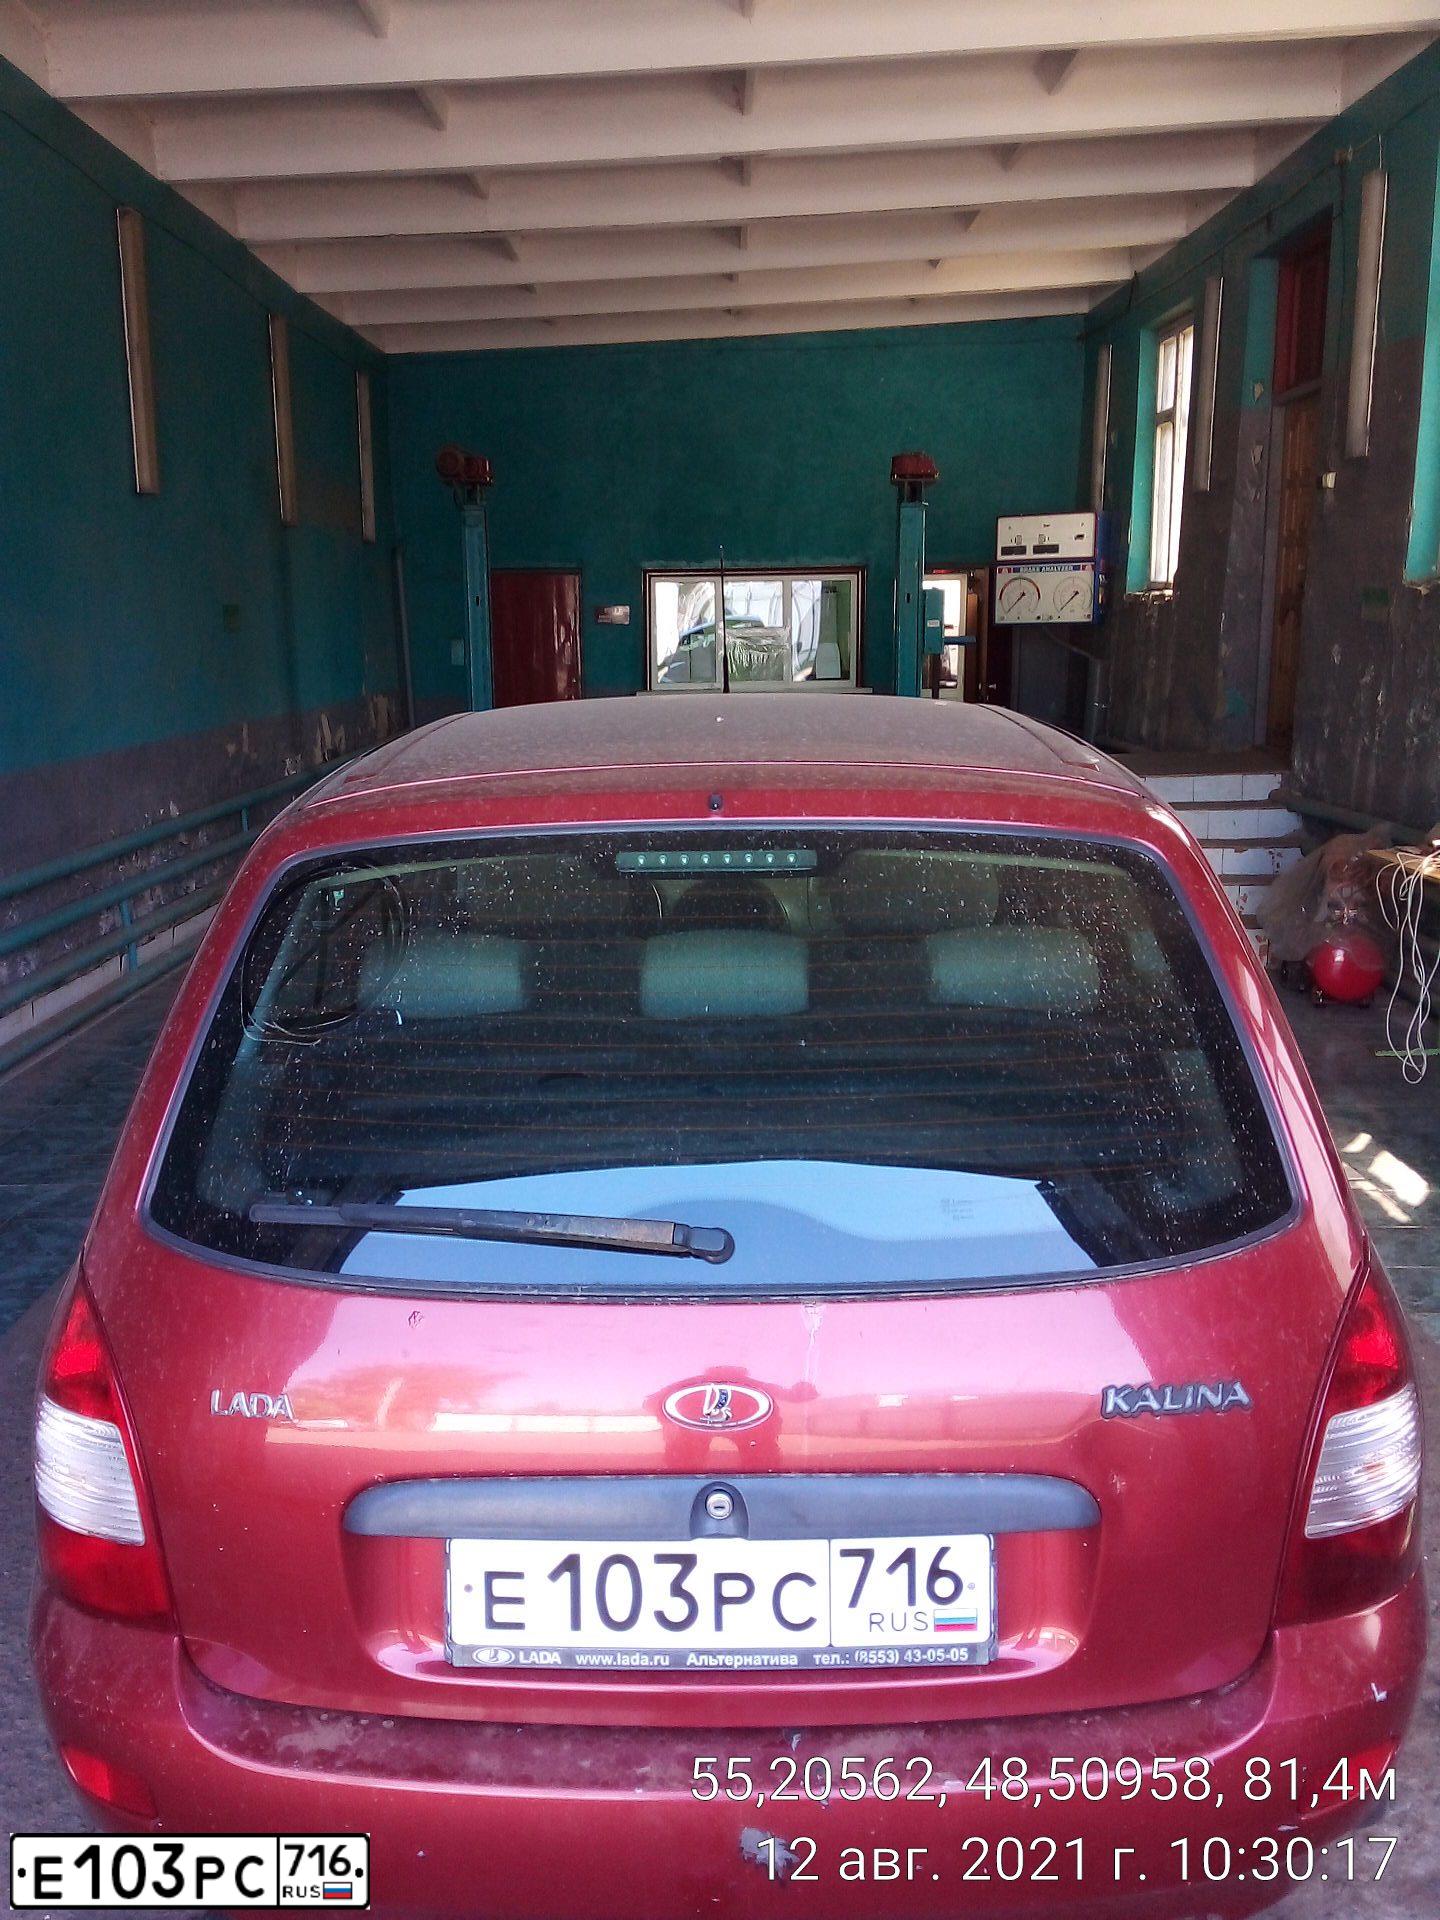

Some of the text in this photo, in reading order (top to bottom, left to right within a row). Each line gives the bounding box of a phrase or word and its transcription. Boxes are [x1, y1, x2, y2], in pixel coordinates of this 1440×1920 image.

[210, 1388, 300, 1423] LADA
[1102, 1381, 1252, 1418] KALINA
[839, 1546, 963, 1608] 716
[869, 1611, 928, 1632] RUS
[518, 1652, 562, 1665] LADA
[575, 1652, 670, 1666] www.lada.ru
[686, 1651, 798, 1668] Альтернатива
[812, 1653, 850, 1665] тел.:
[903, 1647, 969, 1663] 43-05-05
